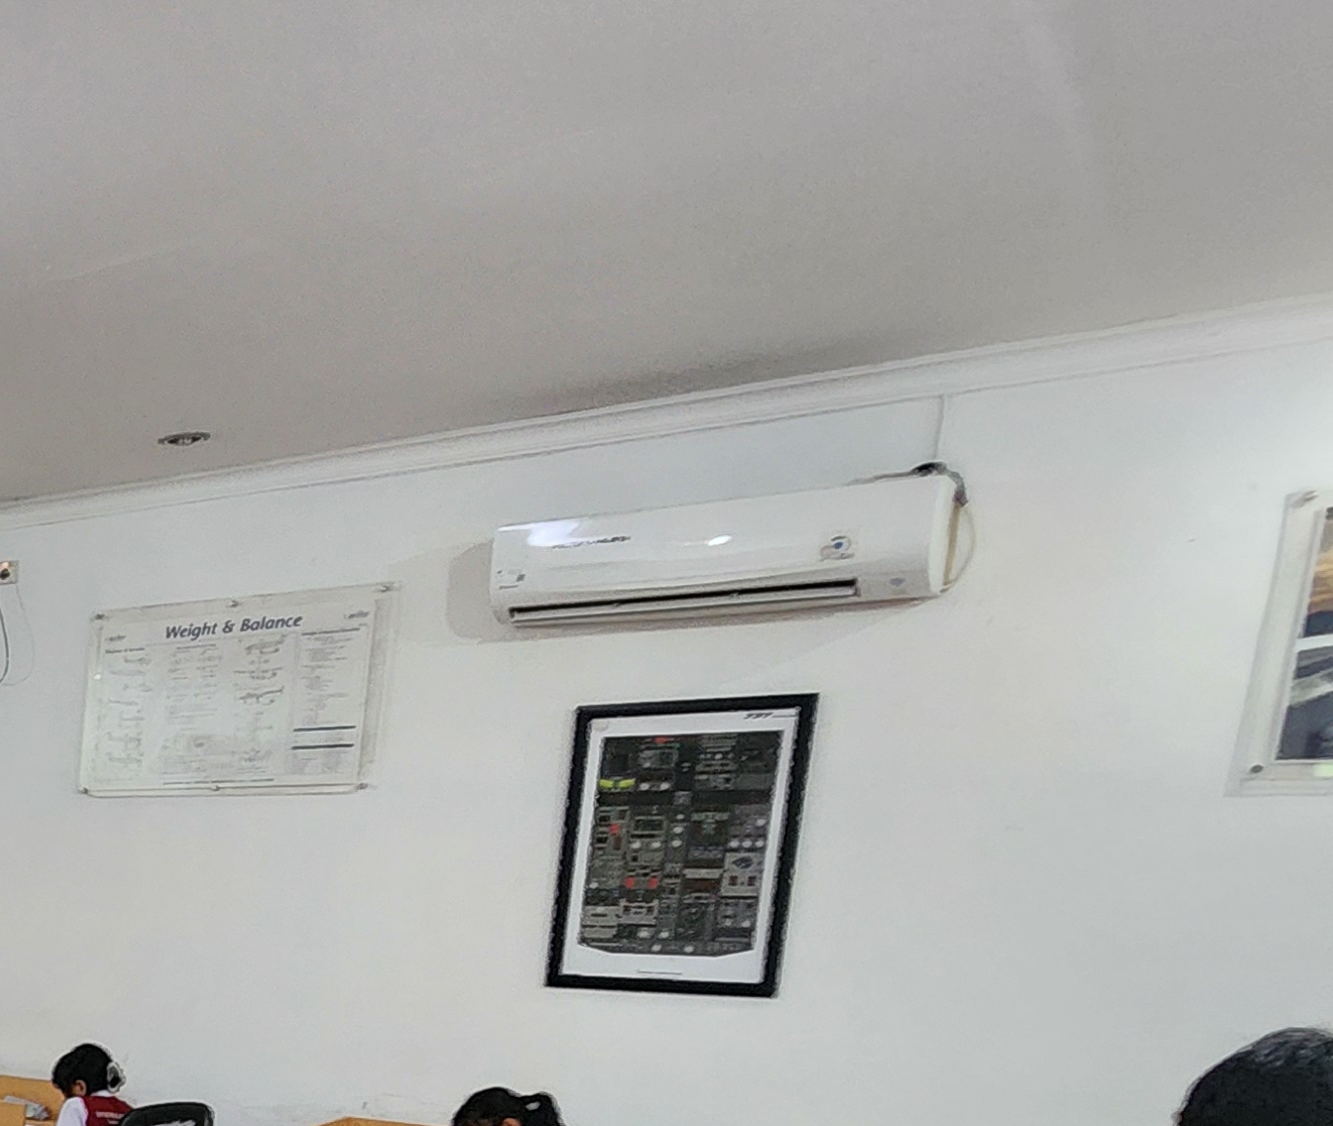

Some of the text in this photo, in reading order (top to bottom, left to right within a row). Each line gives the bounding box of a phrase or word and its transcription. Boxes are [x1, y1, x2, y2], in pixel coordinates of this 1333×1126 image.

[165, 615, 303, 641] Weight & Balance
